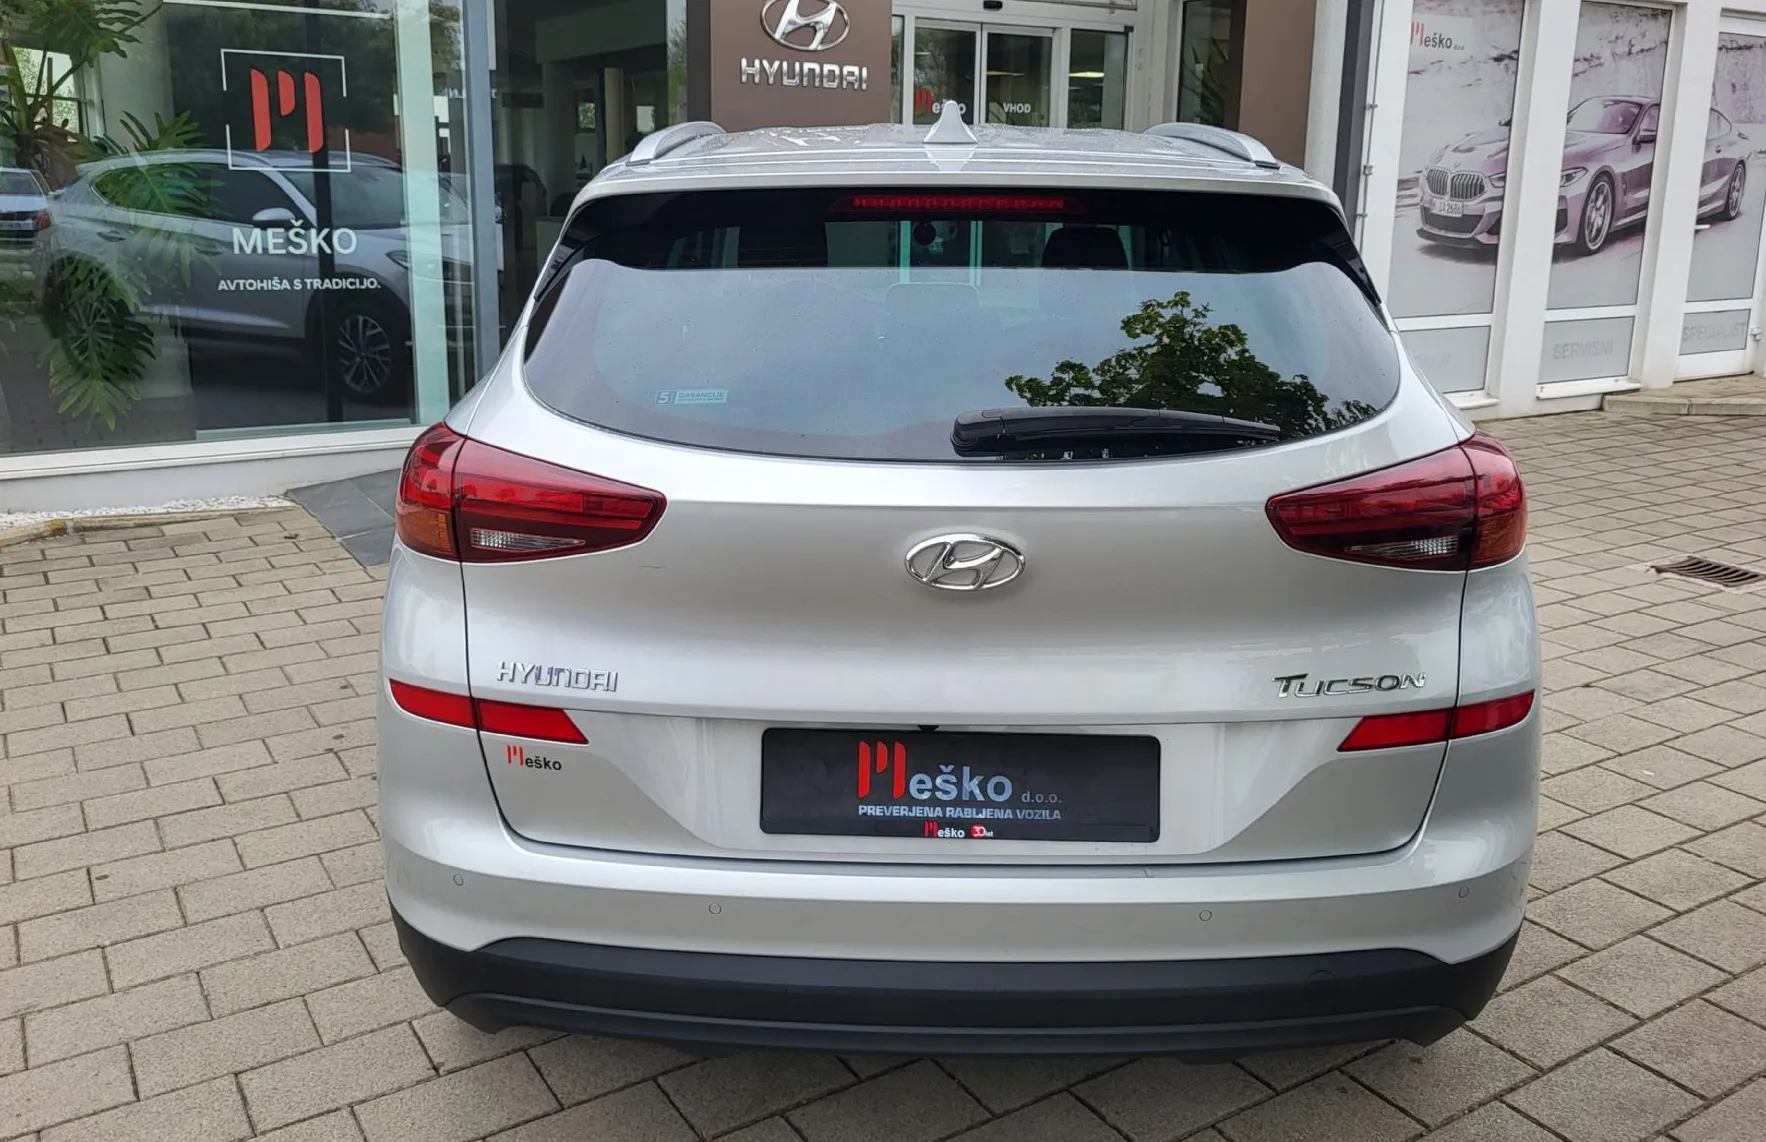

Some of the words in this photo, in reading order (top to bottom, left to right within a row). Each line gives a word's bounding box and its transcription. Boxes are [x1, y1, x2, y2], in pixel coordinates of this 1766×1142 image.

[740, 57, 868, 91] HYUNDAI
[914, 88, 966, 114] Meo
[1003, 101, 1031, 114] VHOD
[232, 219, 357, 255] MEŠKO
[217, 276, 291, 292] AVTOHIŠA
[293, 279, 302, 290] S
[304, 277, 381, 291] TRADICIJO.
[1553, 341, 1614, 360] SERVISNI
[497, 661, 619, 693] HYUNDAI
[506, 744, 562, 771] Meško
[858, 741, 1013, 802] Meško
[1021, 791, 1063, 804] d.o.o.
[858, 805, 944, 818] PREVERJENA
[945, 808, 1013, 819] RABLJENA
[1016, 809, 1062, 820] VOZILA
[924, 819, 965, 838] Meško
